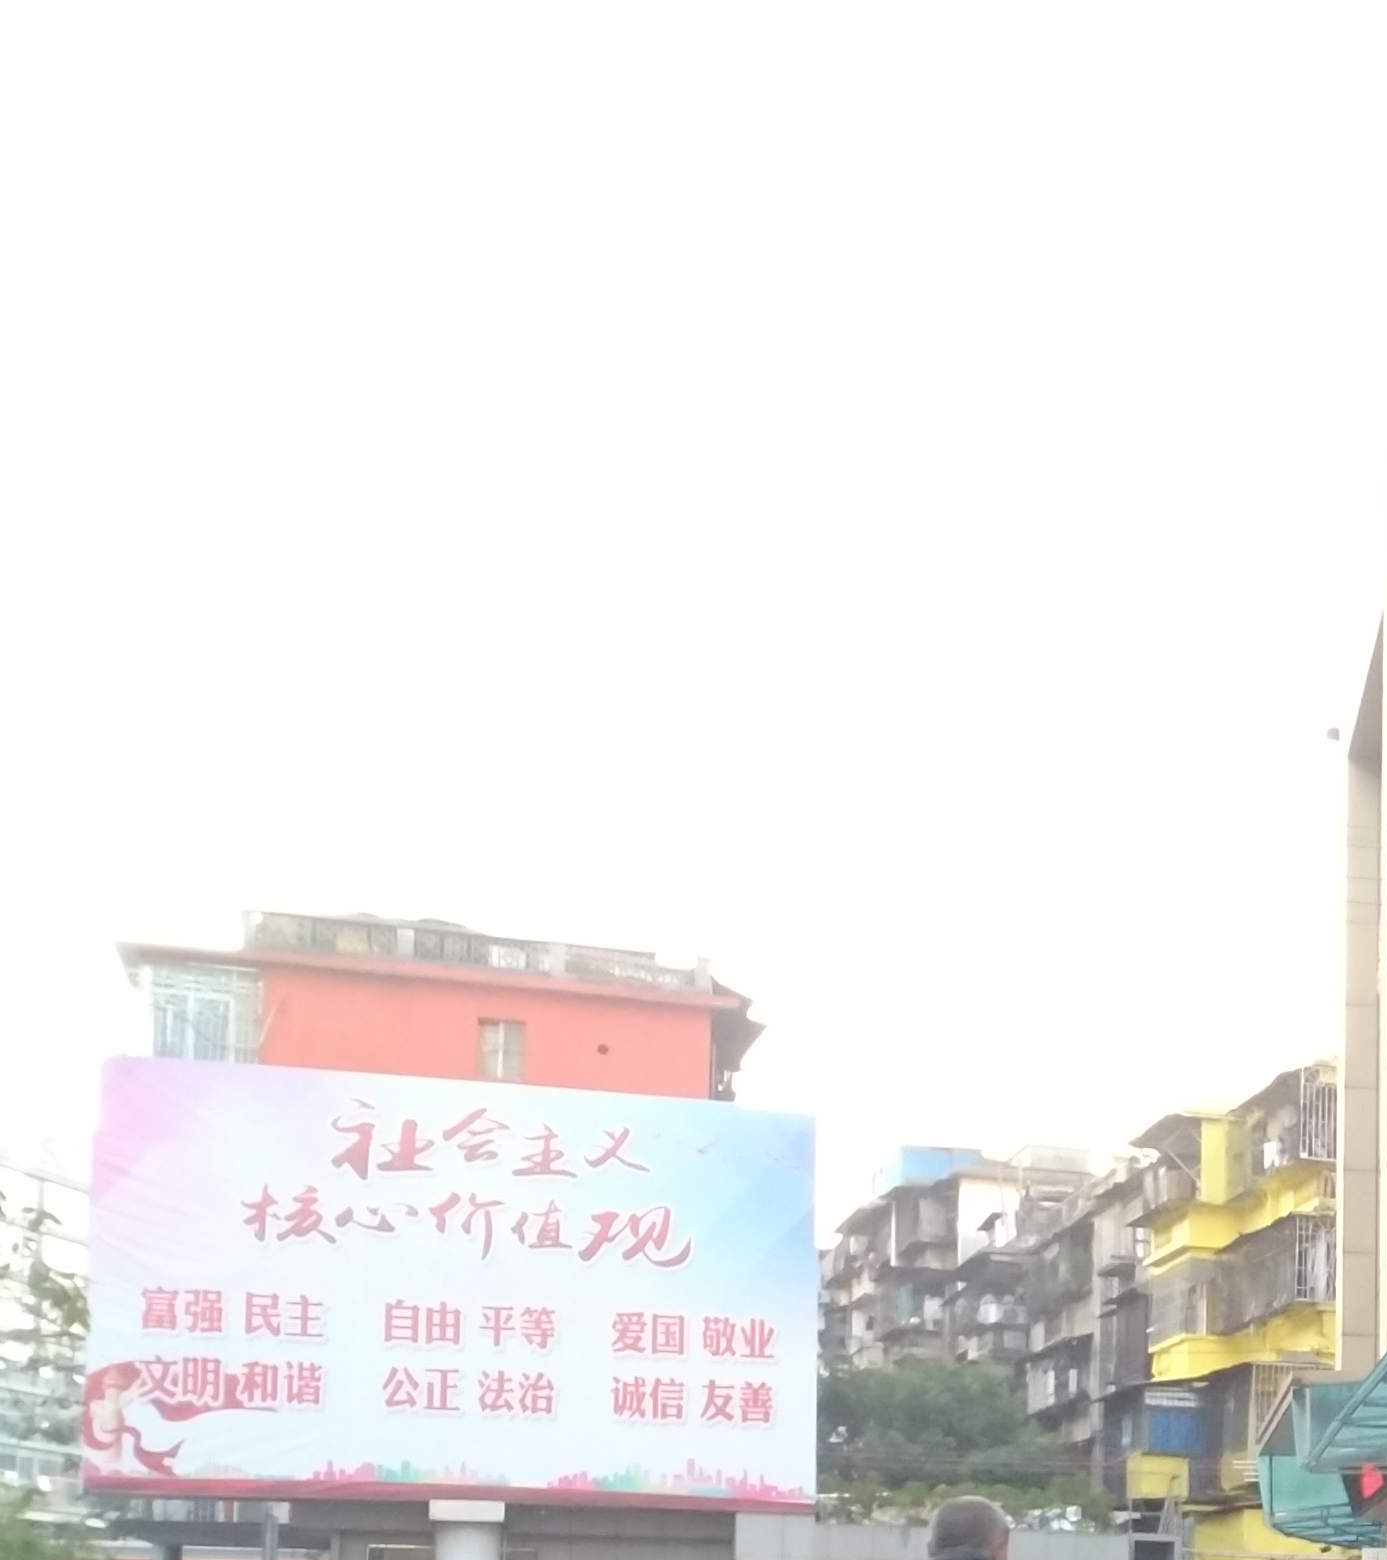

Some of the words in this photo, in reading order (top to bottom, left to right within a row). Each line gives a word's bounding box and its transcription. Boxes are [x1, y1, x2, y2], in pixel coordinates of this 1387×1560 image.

[331, 1098, 651, 1181] 社会主义
[241, 1182, 692, 1268] 核心价值观
[141, 1287, 225, 1334] 富强
[244, 1292, 325, 1340] 民主
[383, 1299, 461, 1347] 自由
[480, 1303, 557, 1350] 平等
[611, 1312, 686, 1357] 爱国
[702, 1316, 775, 1361] 敬业
[139, 1357, 224, 1402] 文明
[241, 1359, 324, 1406] 和谐
[382, 1367, 461, 1413] 公正
[478, 1372, 556, 1415] 法治
[611, 1377, 684, 1421] 诚信
[700, 1378, 774, 1424] 友善
